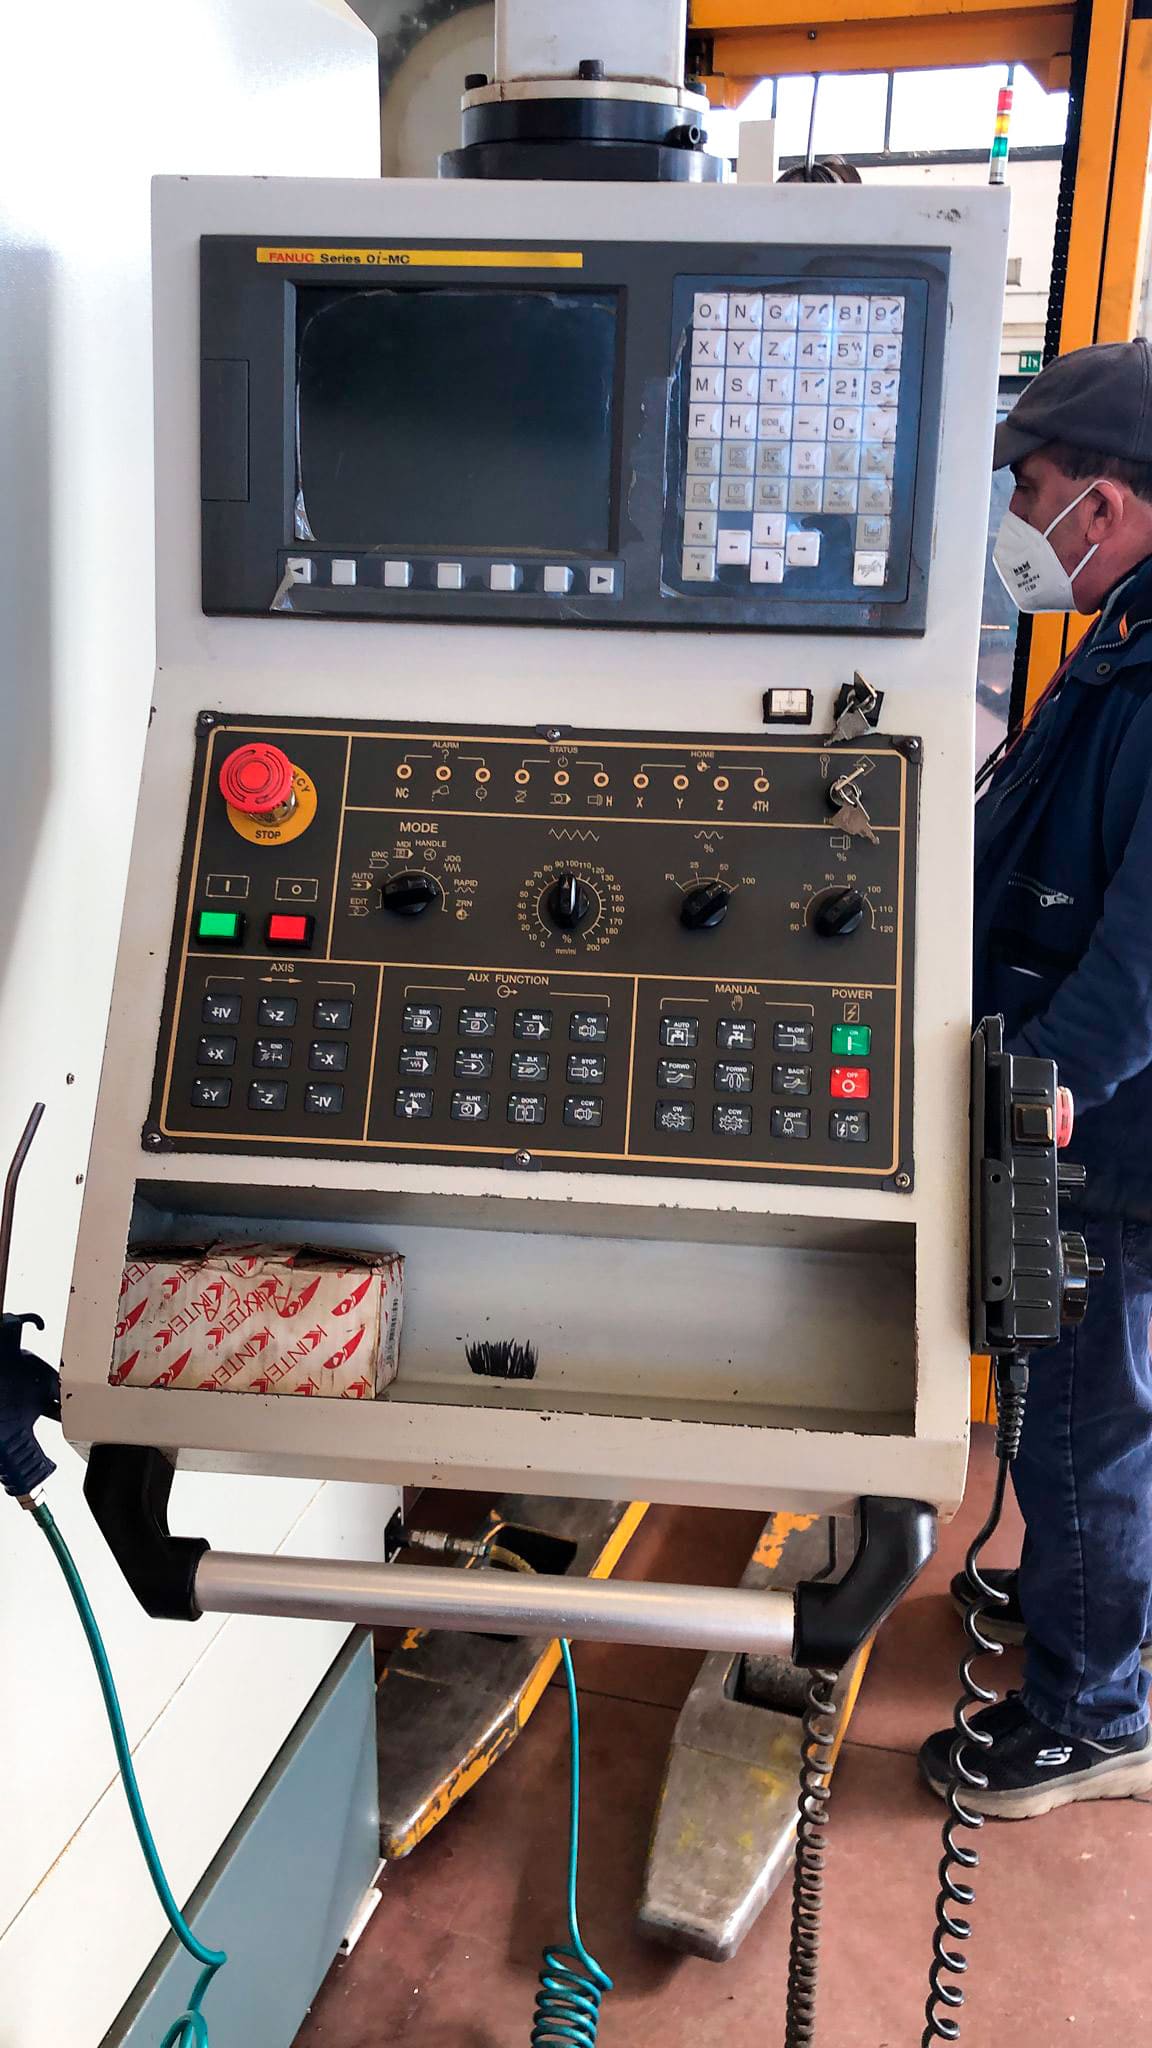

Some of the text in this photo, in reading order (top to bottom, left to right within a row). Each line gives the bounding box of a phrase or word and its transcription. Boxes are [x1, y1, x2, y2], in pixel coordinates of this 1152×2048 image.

[269, 251, 410, 264] FANUC Series 0i-MC
[735, 305, 746, 318] N
[769, 305, 782, 319] G
[804, 306, 816, 319] 7
[839, 306, 851, 320] 8
[875, 307, 887, 321] 9
[698, 341, 709, 354] X
[733, 341, 745, 355] Y
[768, 342, 778, 356] Z
[802, 343, 813, 356] 4
[837, 343, 849, 358] 5
[872, 344, 884, 358] 6
[696, 377, 709, 392] M
[731, 378, 743, 392] S
[767, 379, 777, 392] T
[801, 379, 808, 392] 1
[835, 380, 847, 394] 2
[870, 381, 882, 395] 3
[695, 414, 705, 428] F
[729, 415, 741, 429] H
[433, 741, 459, 749] ALARM
[395, 787, 409, 799] NC
[636, 797, 643, 808] X
[676, 798, 683, 809] Y
[717, 799, 724, 811] Z
[752, 801, 769, 812] 4TH
[400, 822, 439, 833] MODE
[255, 830, 281, 839] STOP
[415, 840, 447, 848] HANDLE
[445, 855, 462, 863] JOG
[352, 872, 374, 880] AUTO
[453, 879, 478, 887] RAPID
[270, 963, 295, 973] AXIS
[467, 973, 550, 985] AUX FUNCTION
[715, 984, 761, 995] MANUAL
[832, 989, 873, 1000] POWER
[269, 1011, 285, 1021] +Z
[325, 1013, 339, 1023] -Y
[207, 1049, 224, 1060] +X
[321, 1054, 334, 1065] -X
[202, 1090, 219, 1101] +Y
[261, 1093, 274, 1104] -Z
[315, 1097, 332, 1107] -IV
